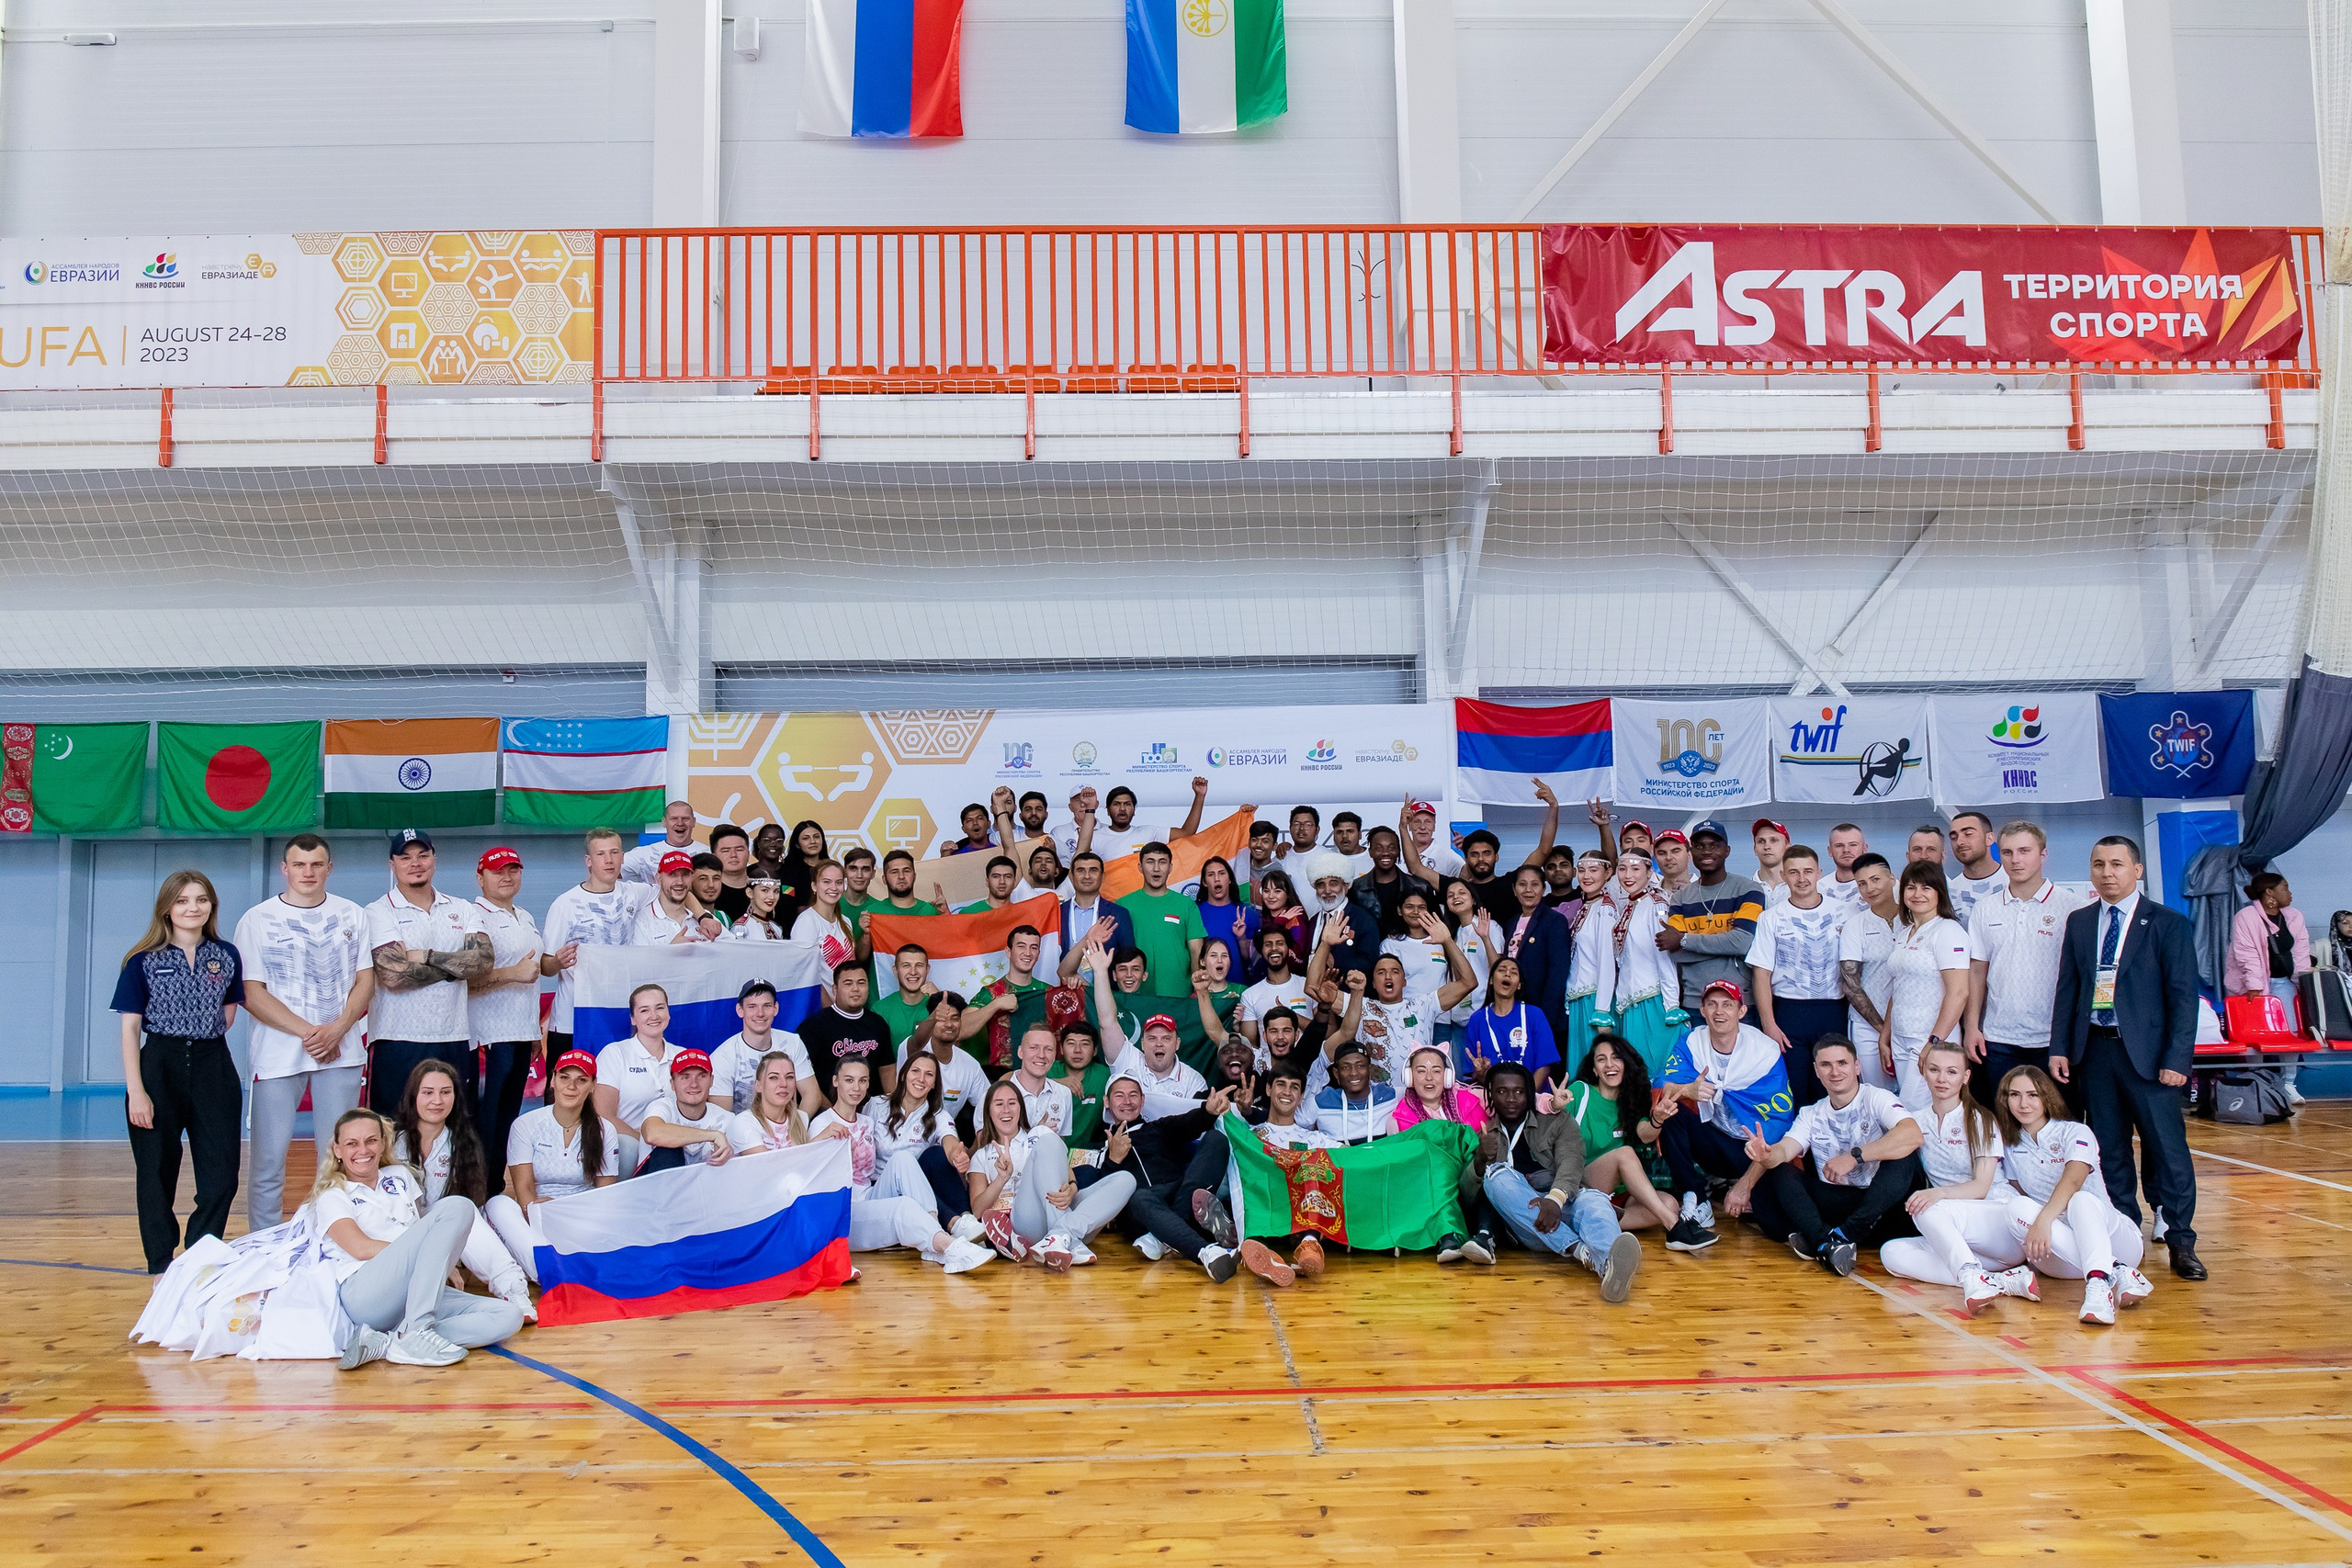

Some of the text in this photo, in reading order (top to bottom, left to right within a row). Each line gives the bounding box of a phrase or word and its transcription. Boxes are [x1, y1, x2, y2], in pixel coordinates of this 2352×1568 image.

[51, 269, 119, 283] ЕВРАЗИИ
[201, 271, 258, 280] ЕВРАЗИАДЕ
[135, 281, 158, 289] КННВС
[2003, 273, 2245, 300] ТЕРРИТОРИЯ
[1615, 241, 1987, 347] ASTRA
[2050, 310, 2208, 338] СПОРТА
[141, 327, 223, 344] AUGUST
[0, 325, 107, 368] UFA
[140, 347, 189, 363] 2023
[1657, 717, 1723, 762] 100
[1708, 733, 1725, 741] ЛЕТ
[2166, 739, 2196, 752] TWIF
[1229, 754, 1287, 766] ЕВРАЗИИ
[1355, 755, 1404, 763] ЕВРАЗИАДЕ
[1663, 761, 1716, 771] 1923 2023
[1645, 778, 1740, 789] МИНИСТЕРСТВО СПОРТА
[2002, 769, 2038, 788] КННВС
[1640, 786, 1745, 798] РОССИЙСКОЙ ФЕДЕРАЦИИ
[488, 852, 501, 863] RUS
[1688, 919, 1736, 931] ULTUR
[831, 1037, 879, 1057] Chicago
[582, 1055, 593, 1065] SIA
